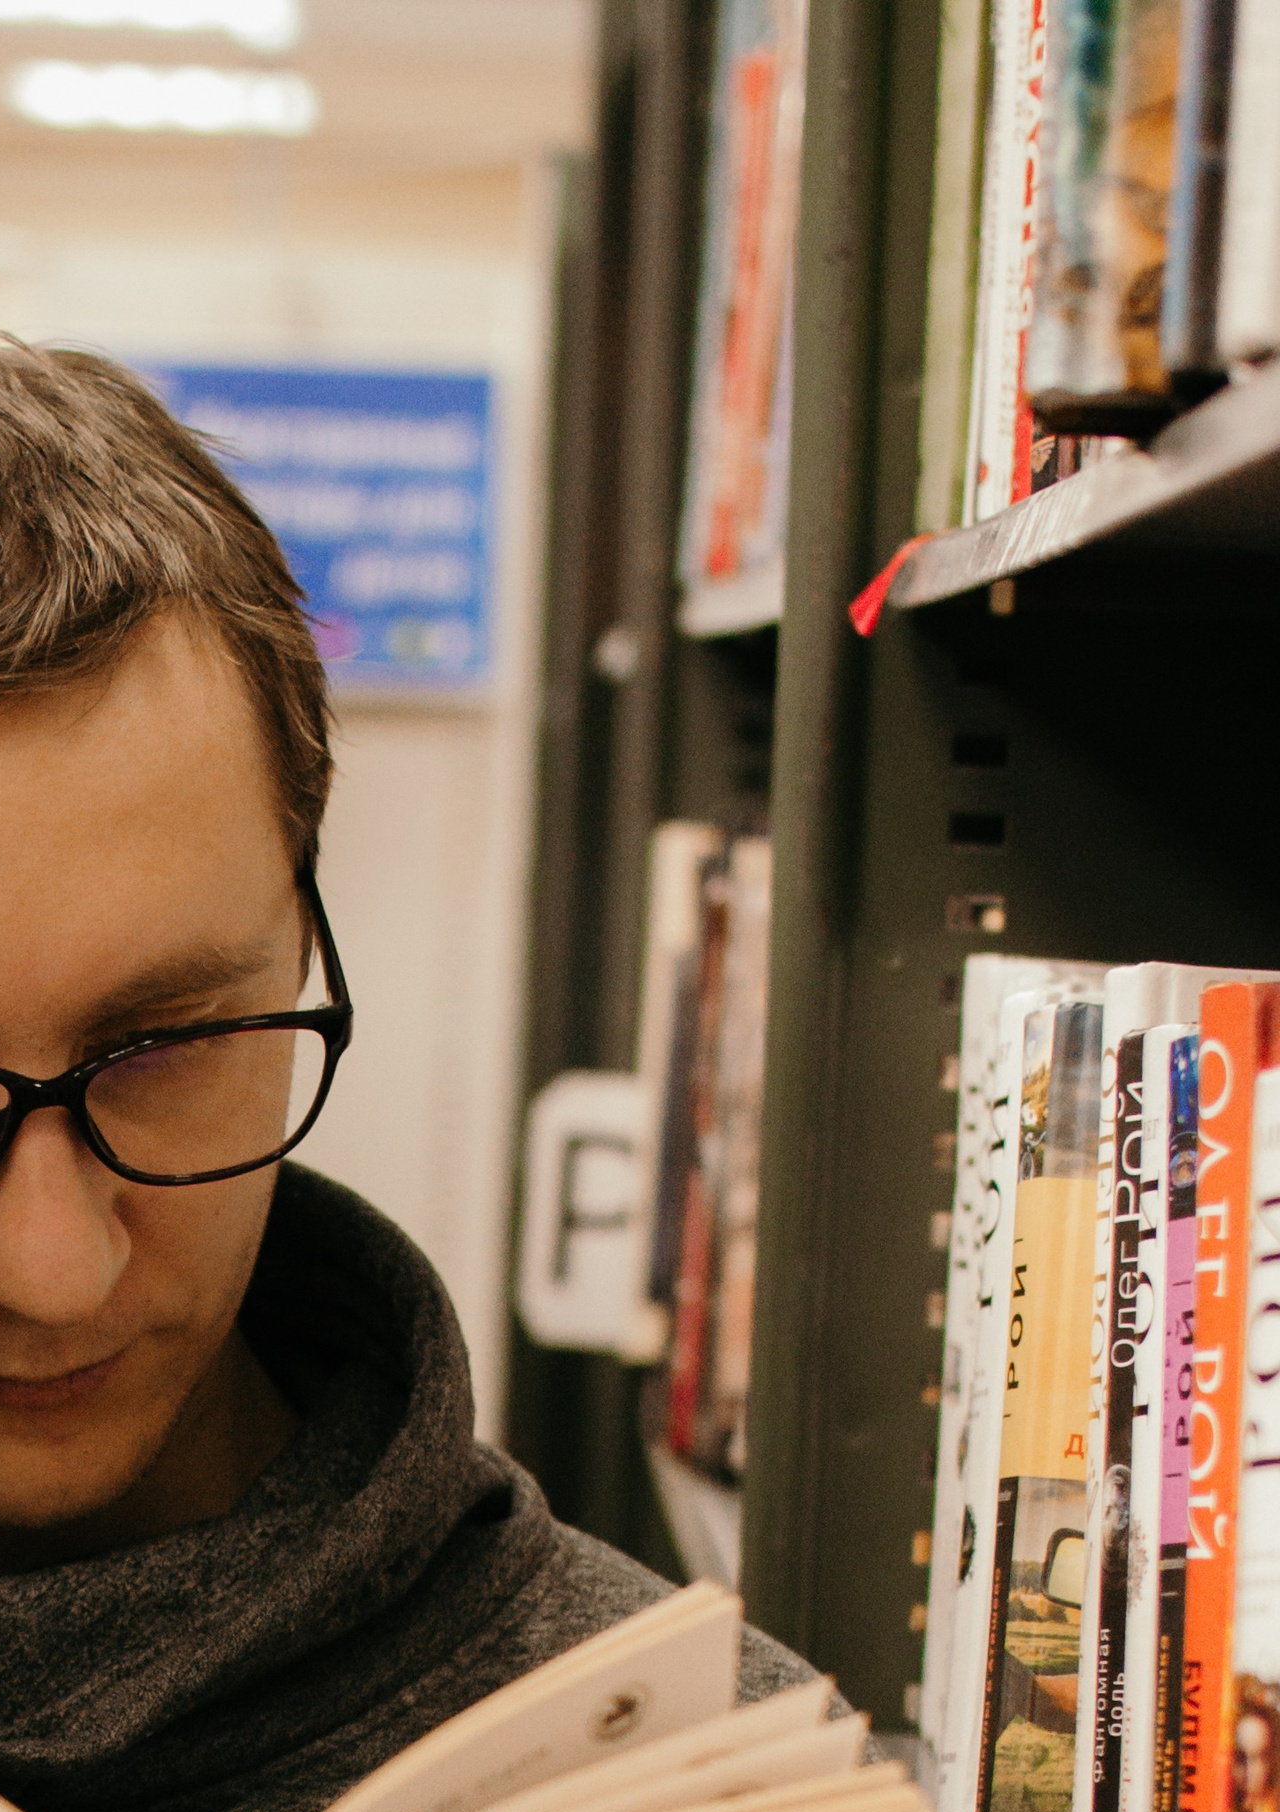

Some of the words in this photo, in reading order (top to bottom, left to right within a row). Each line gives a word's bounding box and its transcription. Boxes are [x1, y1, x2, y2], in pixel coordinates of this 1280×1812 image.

[1194, 1038, 1233, 1297] ОЛЕГ
[1175, 1310, 1194, 1447] РОЙ
[1186, 1344, 1228, 1559] РОЙ
[1092, 1628, 1110, 1783] Фантомная
[1107, 1672, 1125, 1737] боль
[1178, 1660, 1202, 1794] БУДЕМ
